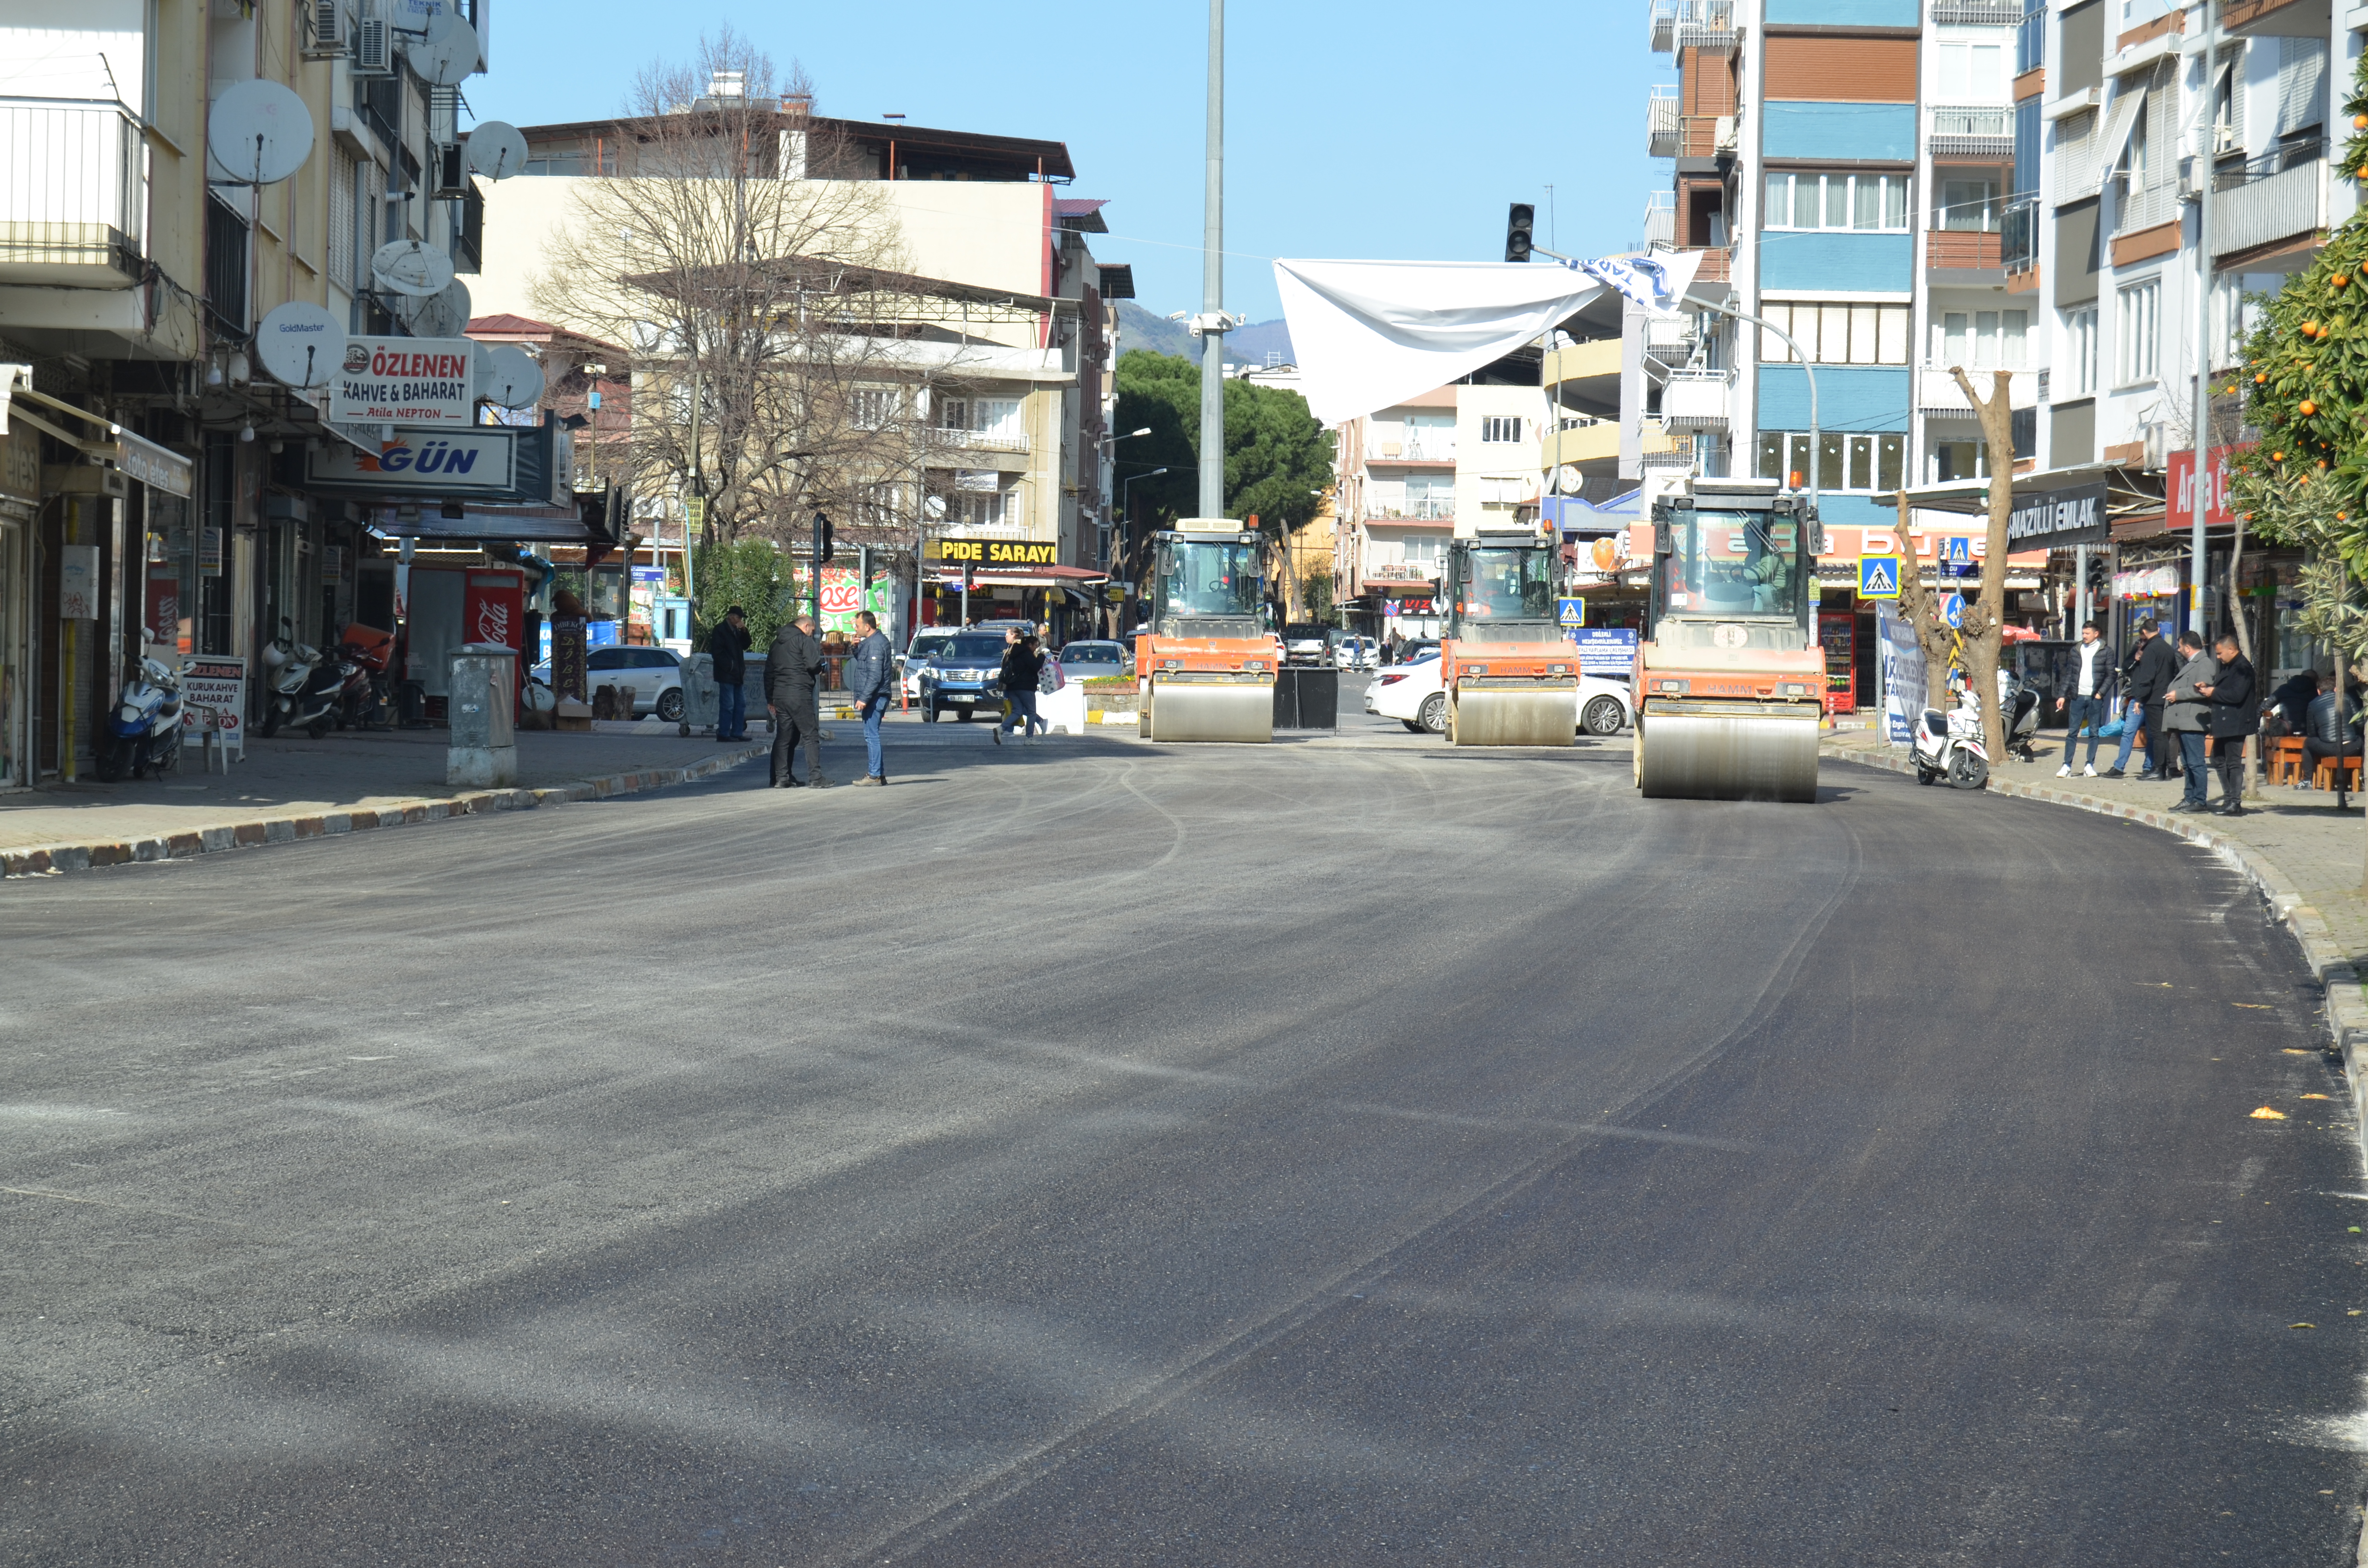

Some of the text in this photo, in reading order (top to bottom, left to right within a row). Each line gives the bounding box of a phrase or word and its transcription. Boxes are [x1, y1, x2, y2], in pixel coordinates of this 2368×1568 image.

[280, 324, 324, 332] GoldMaster
[372, 345, 467, 378] ÖZLENEN
[343, 380, 465, 402] KAHVE & BAHARAT
[366, 407, 441, 418] Atila NEPTON
[378, 441, 479, 474] GÜN
[150, 458, 169, 489] efes
[2177, 464, 2213, 514] Ara
[2056, 497, 2098, 532] EMLAK
[989, 543, 1055, 563] SARAYI
[187, 682, 238, 692] KURUKAHVE
[1708, 685, 1752, 694] HAMM
[190, 693, 234, 703] BAHARAT
[186, 715, 236, 728] NPON
